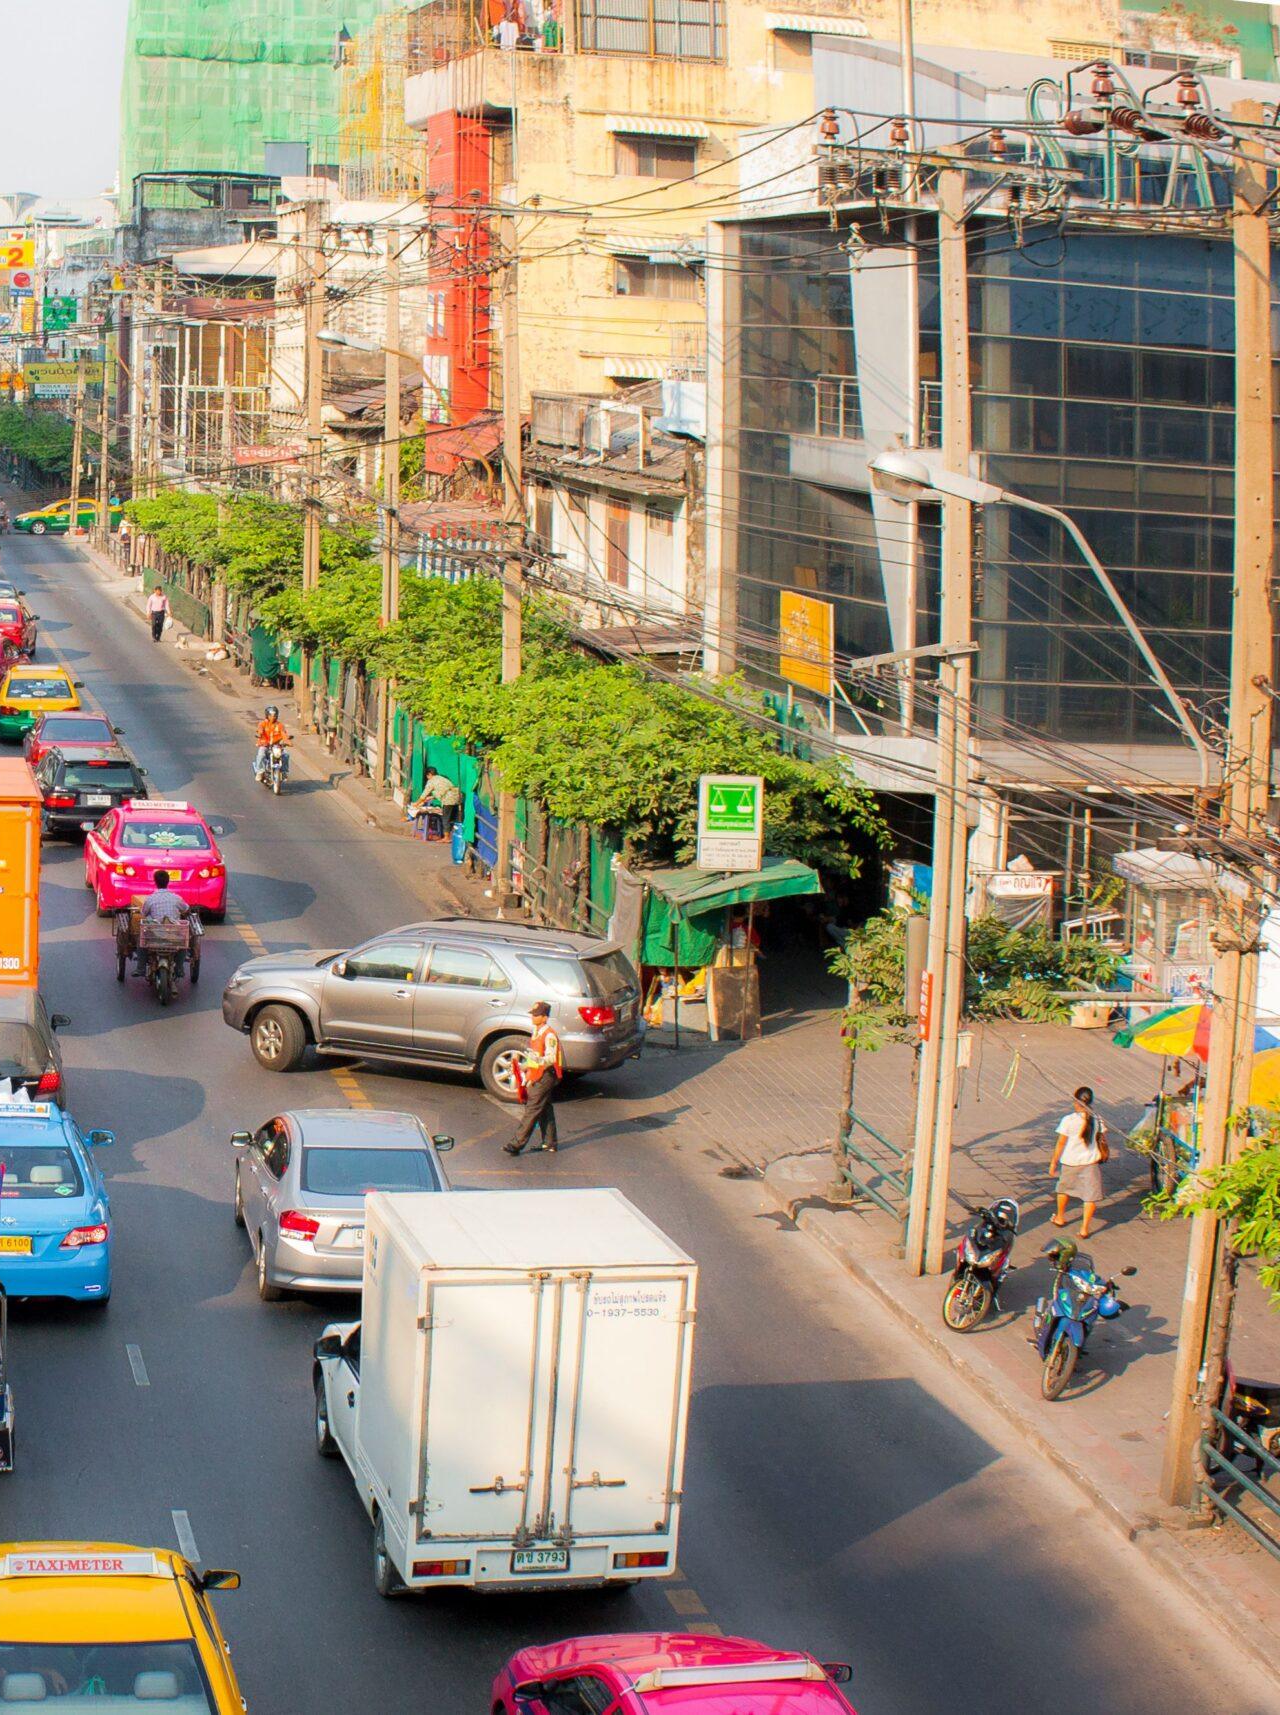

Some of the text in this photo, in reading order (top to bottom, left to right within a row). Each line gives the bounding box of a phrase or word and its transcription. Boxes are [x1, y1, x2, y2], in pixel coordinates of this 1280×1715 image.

[7, 247, 24, 267] 2
[6, 1238, 30, 1247] 6100
[586, 1308, 660, 1318] 0-1937-5530
[537, 1551, 566, 1563] 3793
[27, 1559, 123, 1571] TAXI-METER
